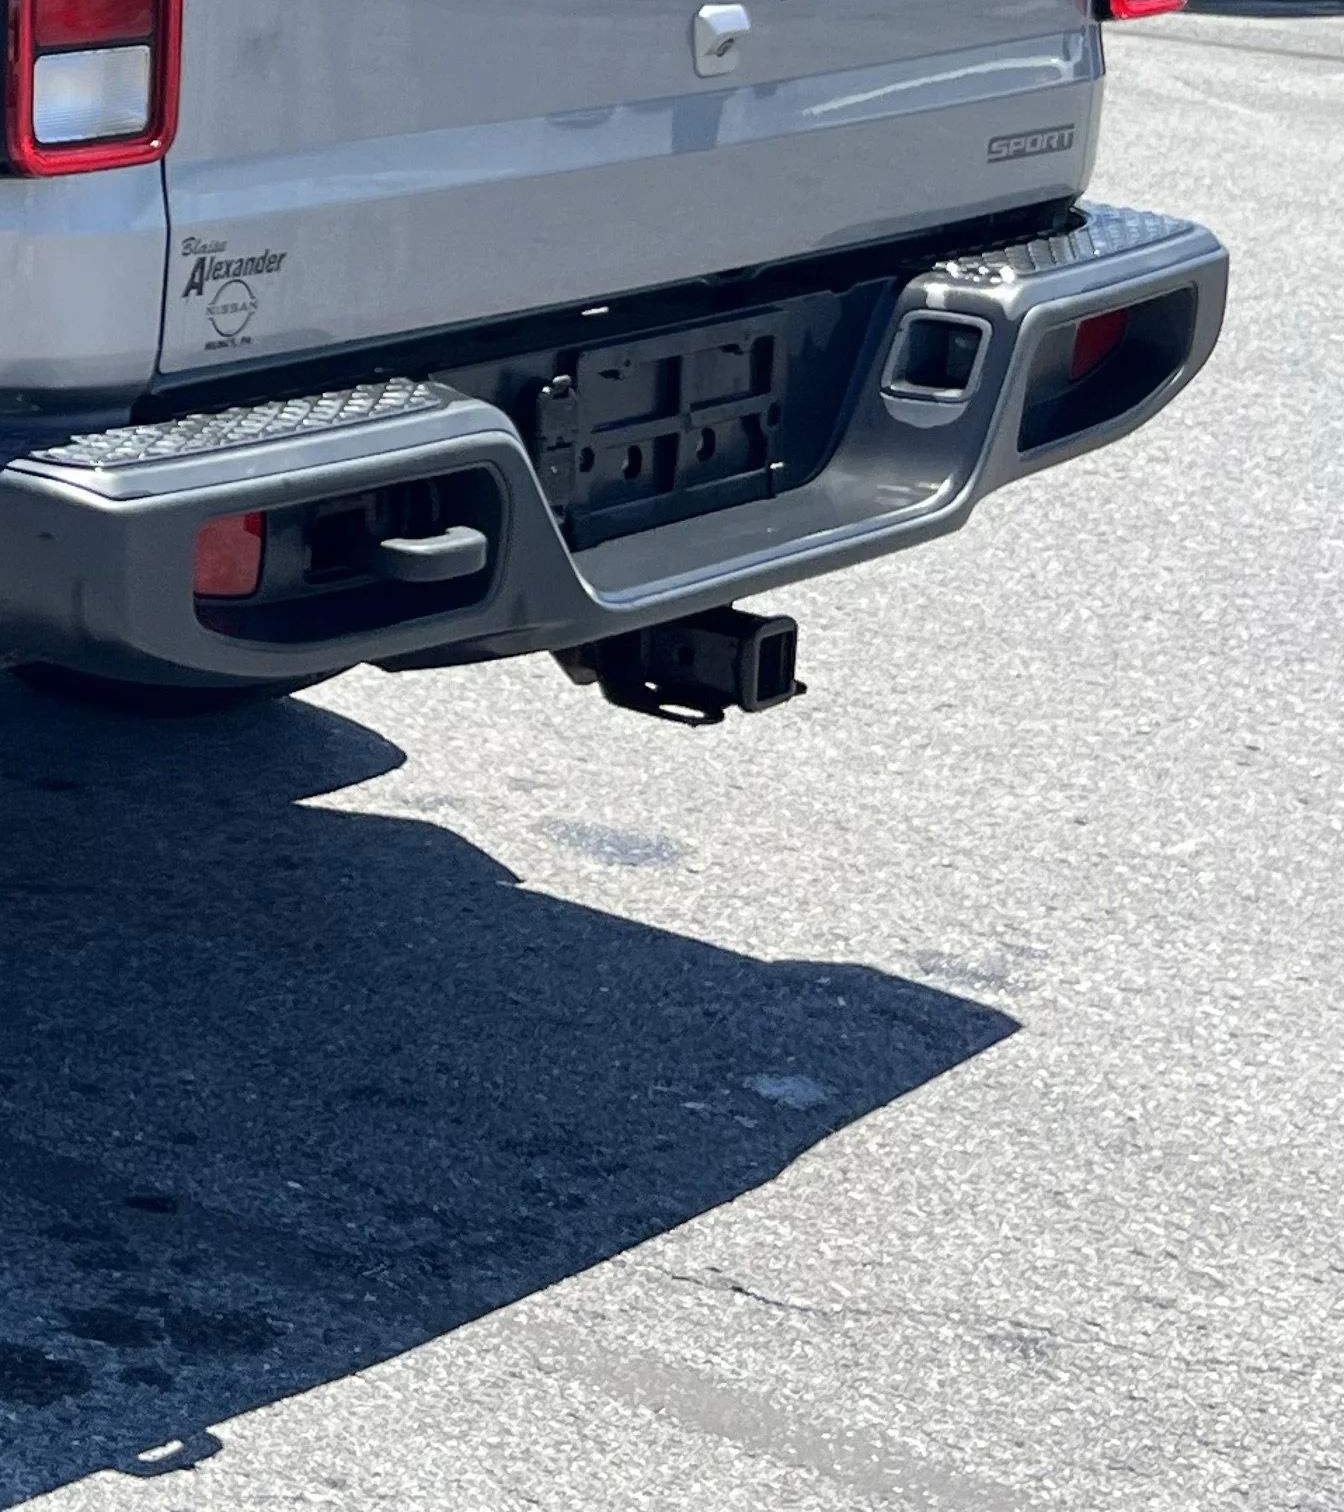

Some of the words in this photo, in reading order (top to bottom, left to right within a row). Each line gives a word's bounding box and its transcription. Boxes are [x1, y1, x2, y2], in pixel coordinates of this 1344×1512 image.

[987, 126, 1076, 161] SPORT
[181, 248, 288, 298] Alexander
[206, 300, 259, 316] NISSAN
